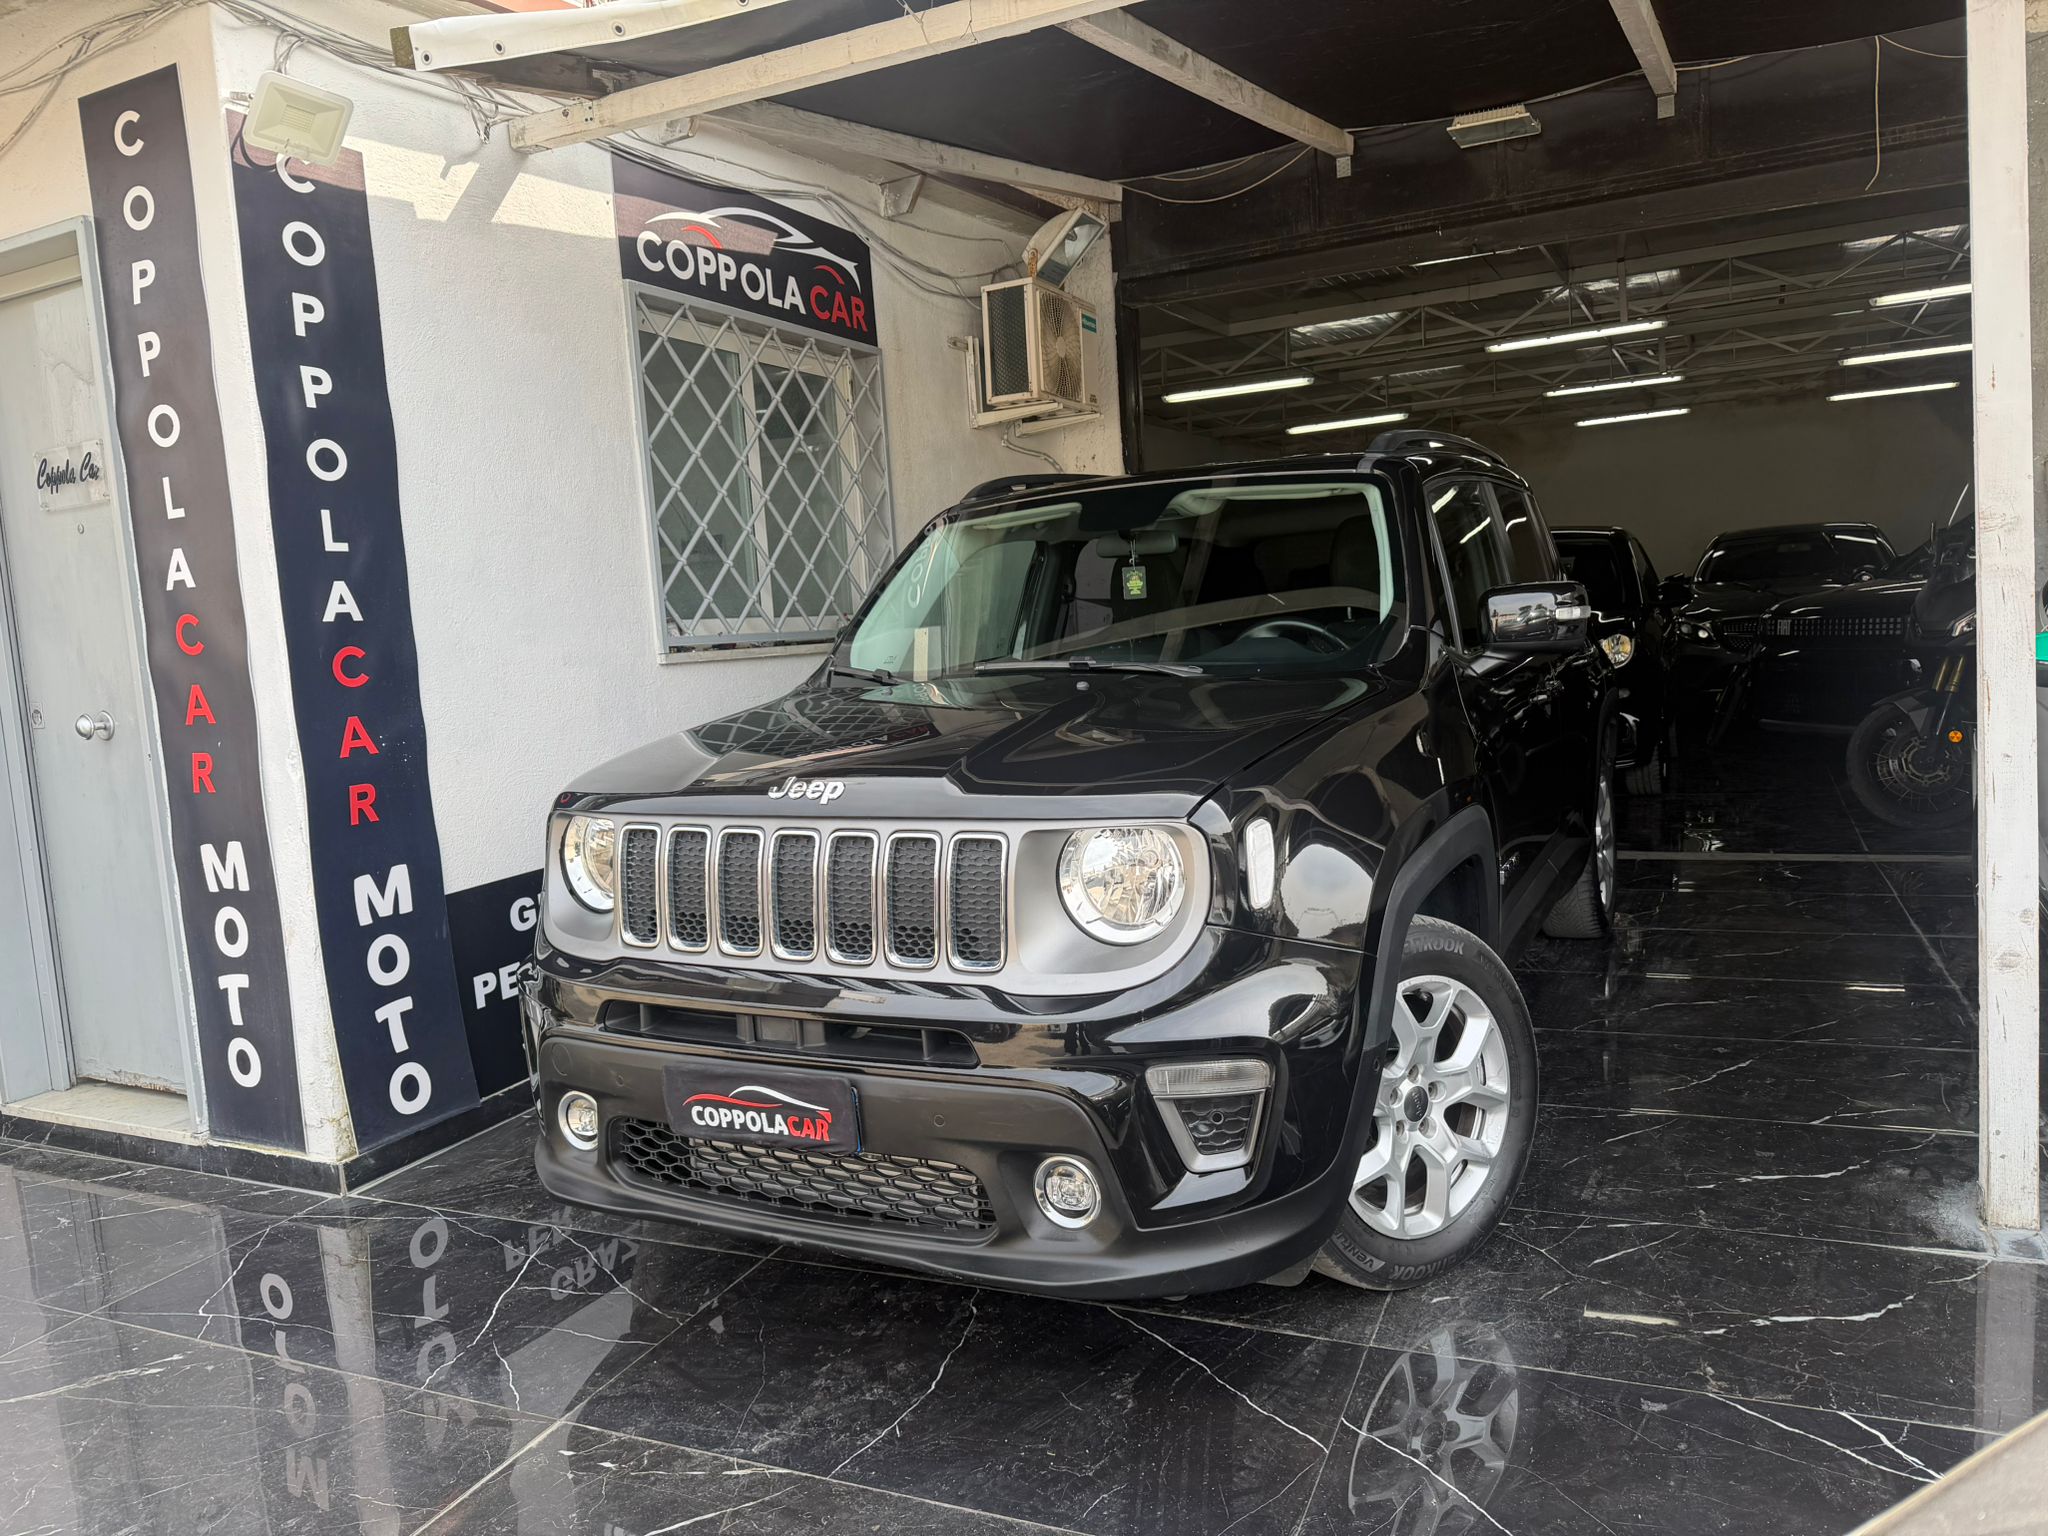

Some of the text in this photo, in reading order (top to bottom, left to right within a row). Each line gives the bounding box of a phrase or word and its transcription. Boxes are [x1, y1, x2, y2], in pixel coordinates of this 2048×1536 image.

[37, 451, 99, 495] Coppola Car
[768, 776, 846, 805] Jeep
[200, 841, 262, 1088] MOTO
[353, 864, 432, 1115] MOTO
